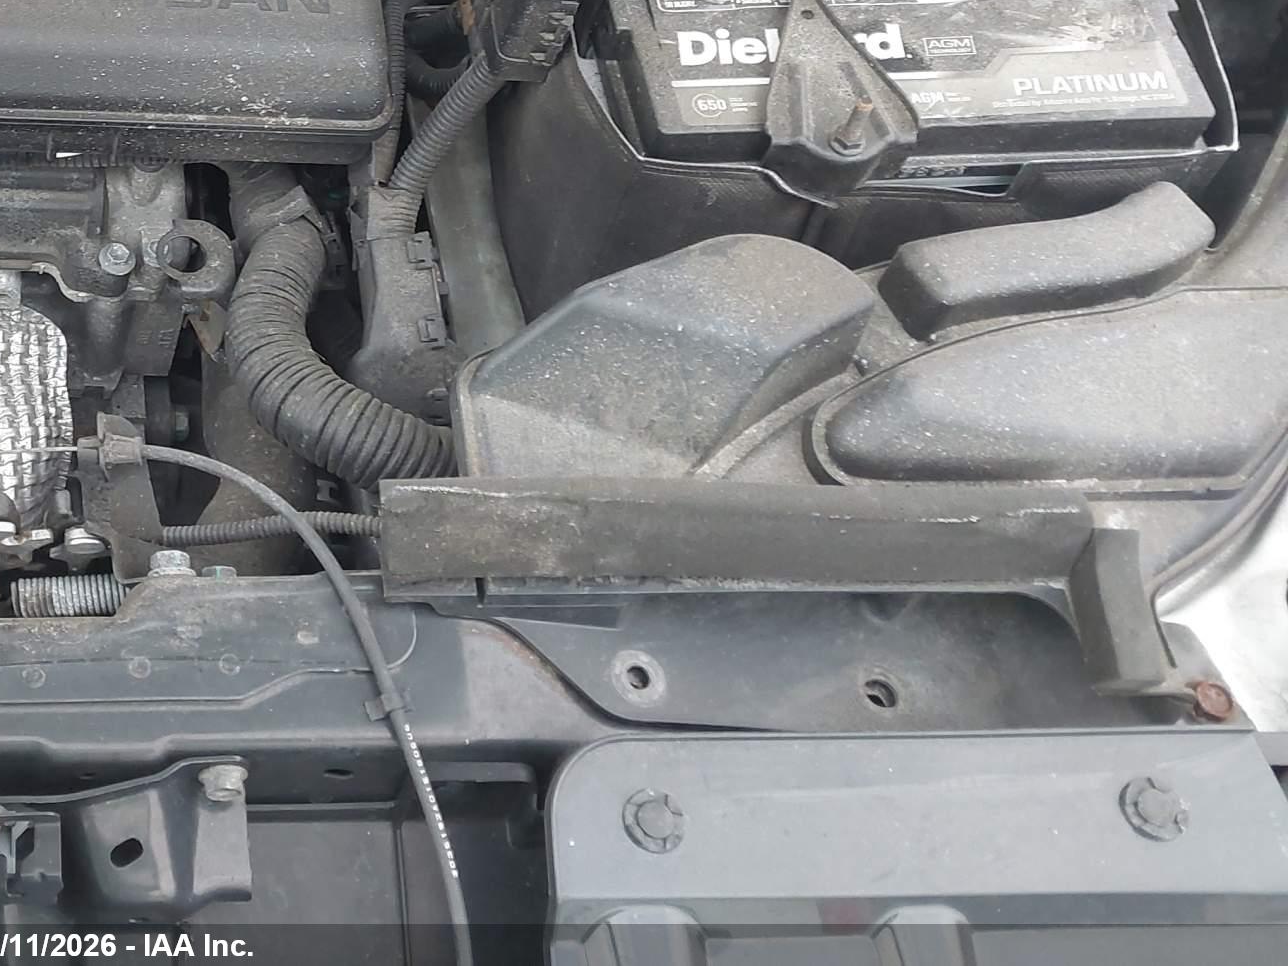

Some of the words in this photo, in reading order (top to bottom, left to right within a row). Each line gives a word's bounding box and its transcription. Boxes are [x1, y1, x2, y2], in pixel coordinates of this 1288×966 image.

[927, 38, 972, 48] AGM
[1013, 70, 1169, 96] PLATINUM
[696, 98, 727, 111] 650
